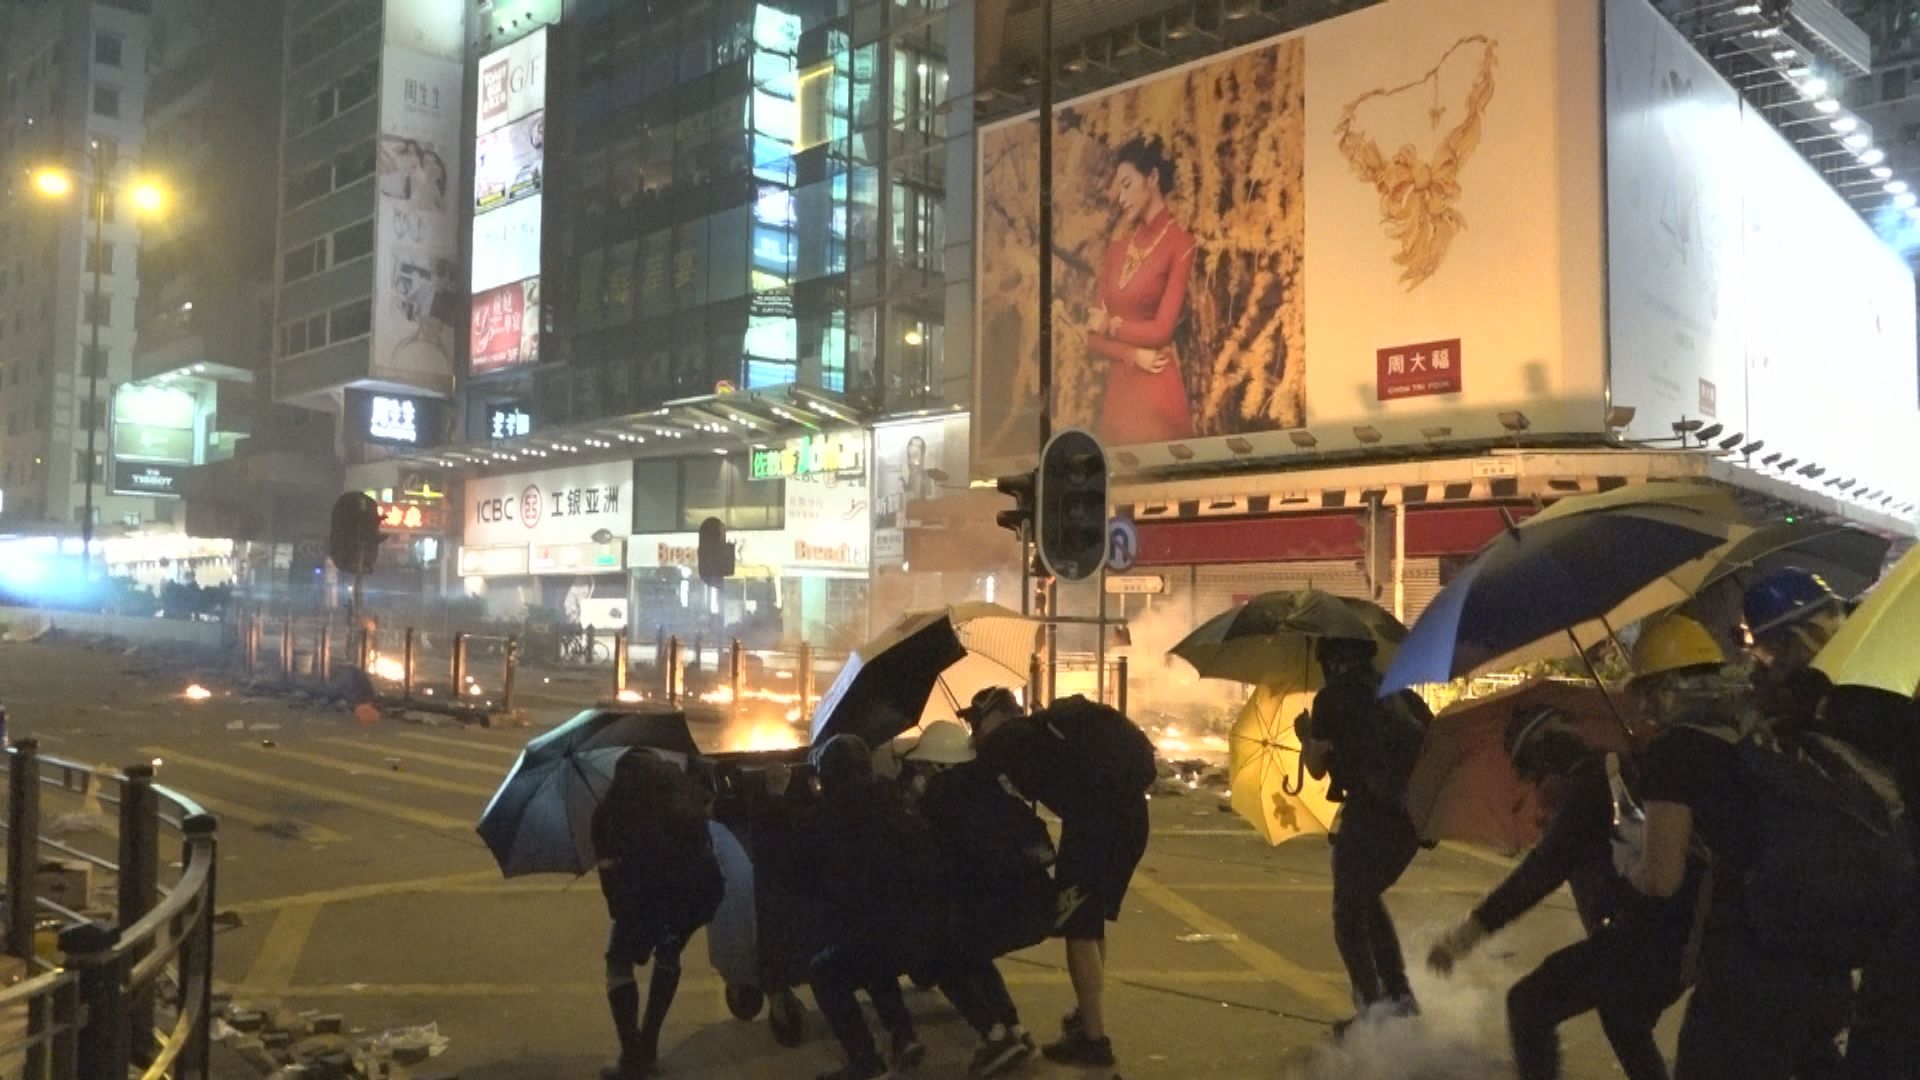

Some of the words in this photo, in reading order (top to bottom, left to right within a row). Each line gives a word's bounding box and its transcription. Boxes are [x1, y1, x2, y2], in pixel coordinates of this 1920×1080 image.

[1387, 348, 1449, 375] 周大福
[476, 497, 514, 525] ICBC
[551, 485, 619, 517] 工银亚洲
